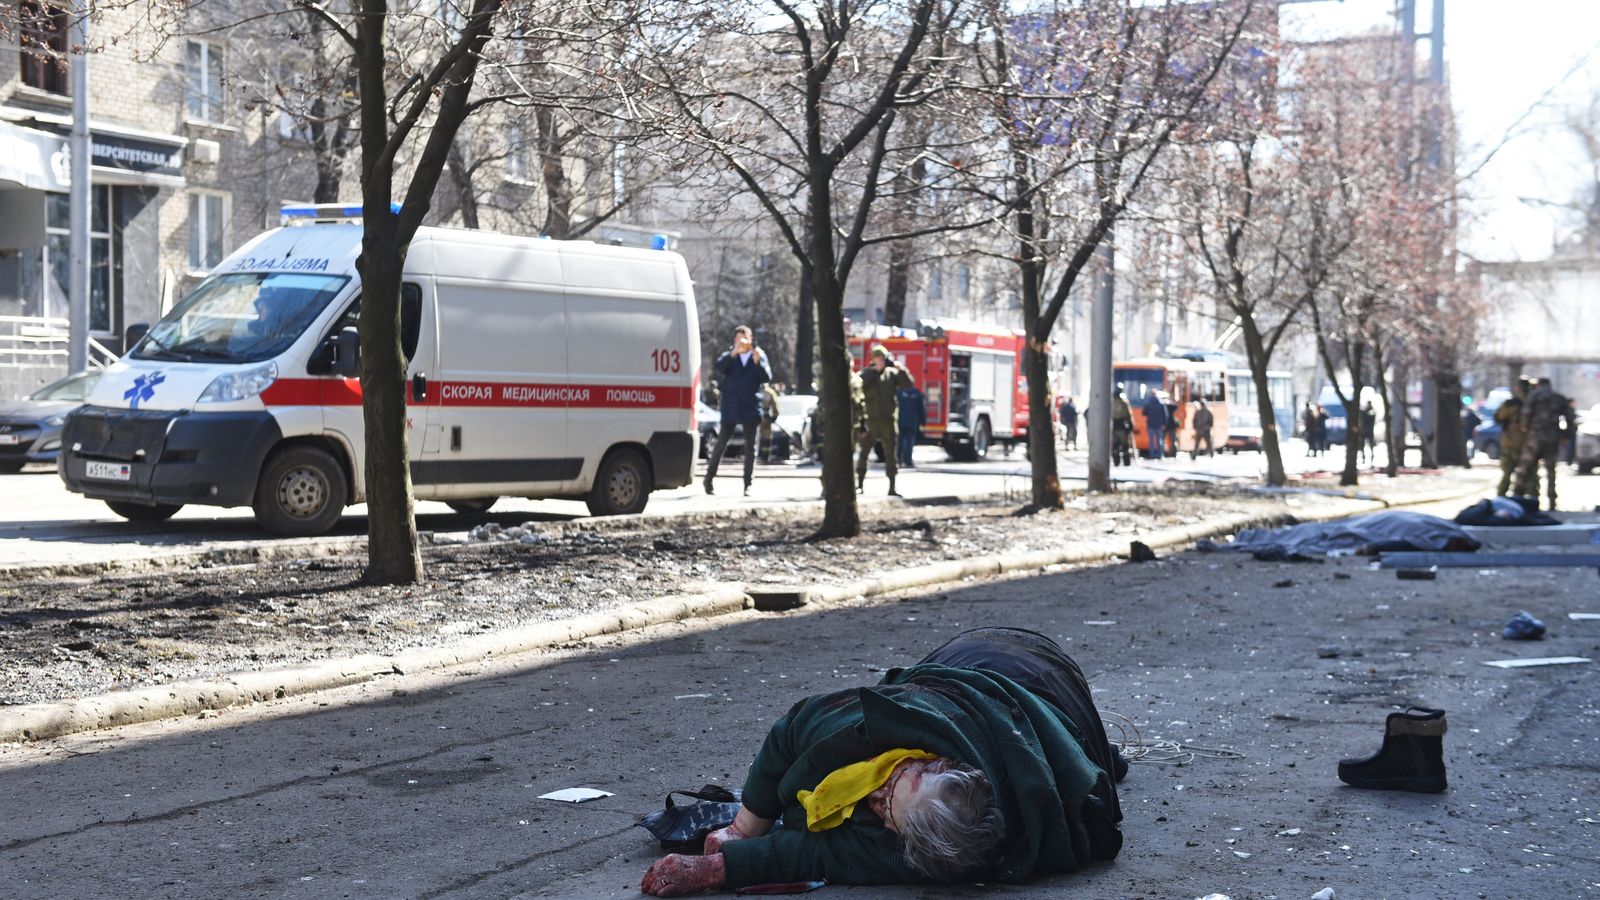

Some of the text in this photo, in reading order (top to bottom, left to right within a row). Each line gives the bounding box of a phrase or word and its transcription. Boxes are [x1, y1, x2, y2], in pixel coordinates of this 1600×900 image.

[651, 348, 681, 373] 103
[441, 385, 656, 403] СКОРАЯ МЕДИЦИНСКАЯ ПОМОЩЬ
